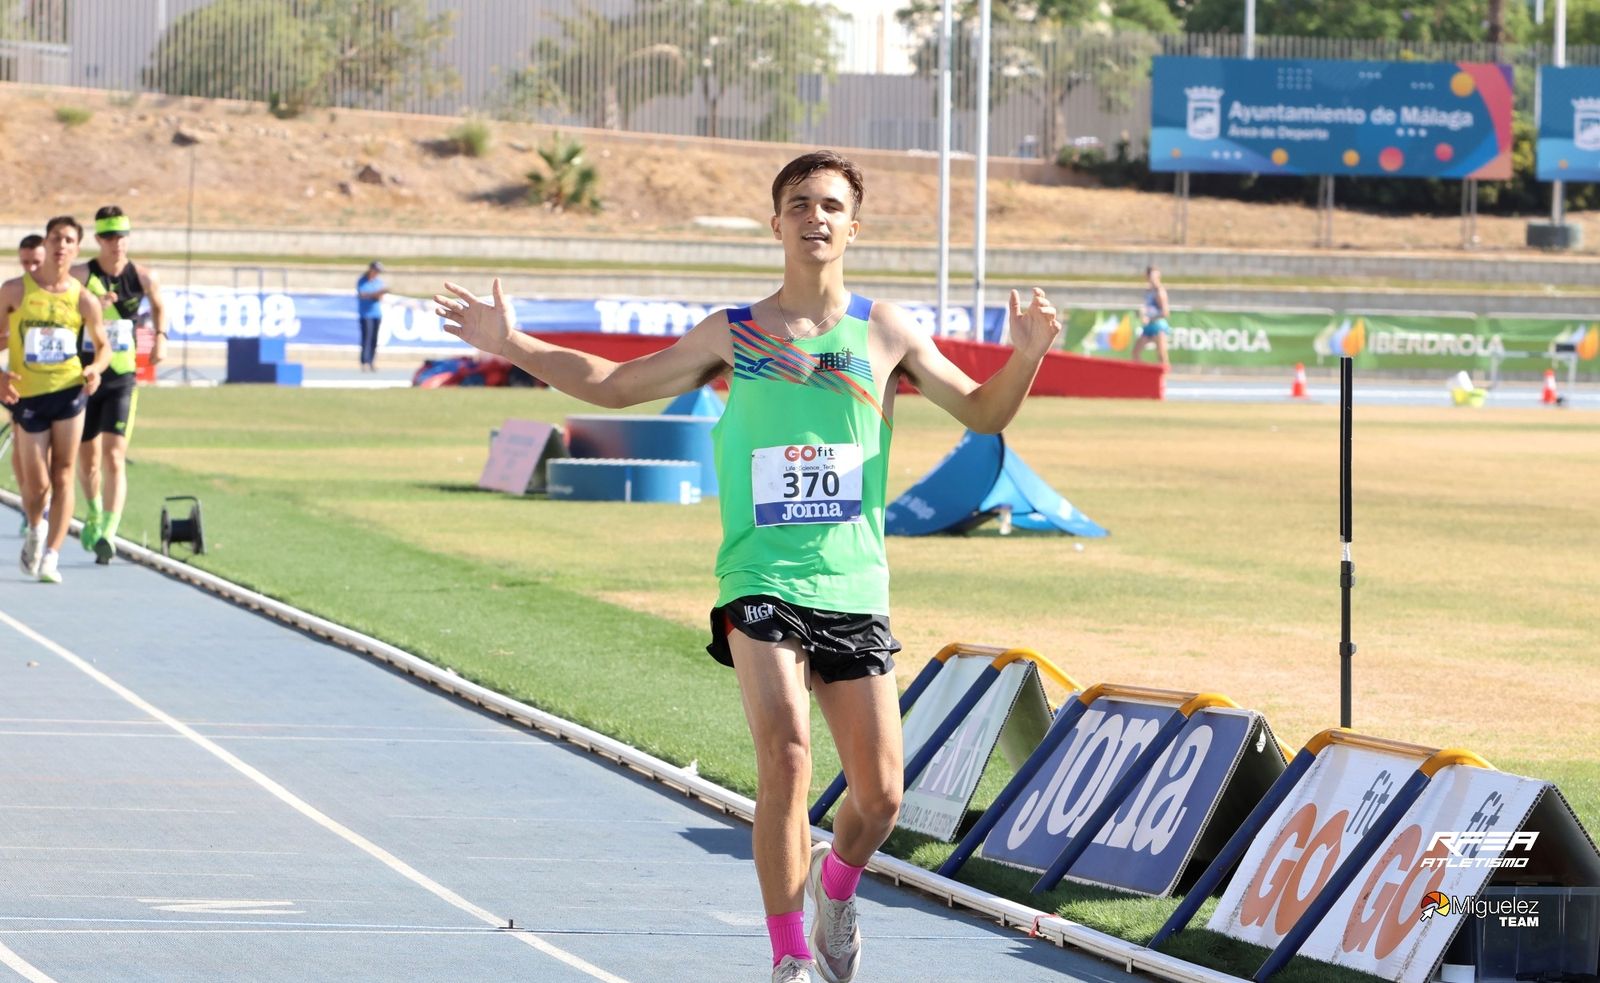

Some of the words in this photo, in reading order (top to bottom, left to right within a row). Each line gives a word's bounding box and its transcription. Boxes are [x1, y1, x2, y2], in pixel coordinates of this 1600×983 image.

[1228, 100, 1366, 124] Ayuntamiento
[1370, 106, 1397, 125] de
[1401, 106, 1473, 130] Málaga
[1278, 126, 1329, 142] Deporte
[1368, 331, 1505, 356] IBERDROLA
[783, 471, 840, 498] 370
[1240, 803, 1349, 936] GO
[1342, 823, 1450, 961] GO
